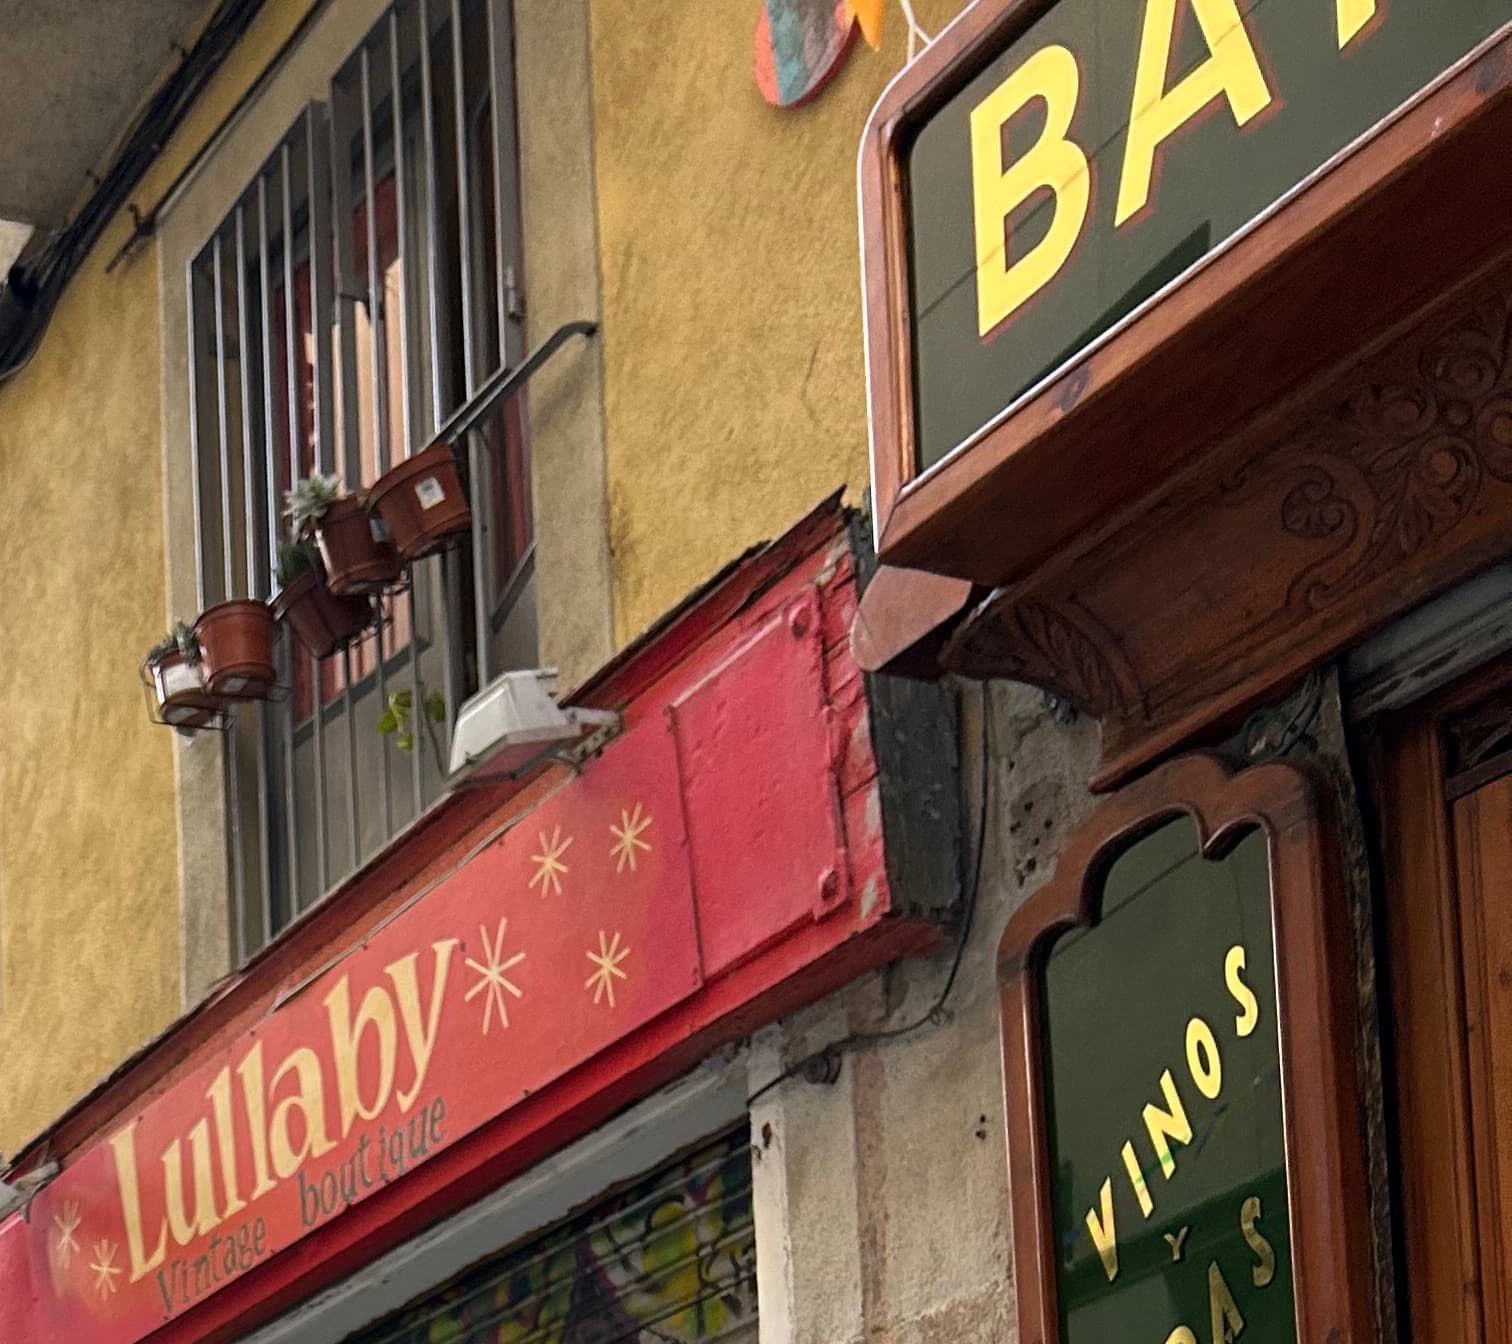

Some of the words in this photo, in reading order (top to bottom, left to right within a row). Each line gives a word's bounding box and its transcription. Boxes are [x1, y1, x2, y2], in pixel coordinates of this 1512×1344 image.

[970, 0, 1376, 337] BA
[108, 937, 463, 1284] Lullaby
[155, 1216, 267, 1313] Vintage
[297, 1096, 446, 1228] boutique
[1085, 943, 1259, 1282] VINOS
[1165, 1226, 1190, 1263] Y
